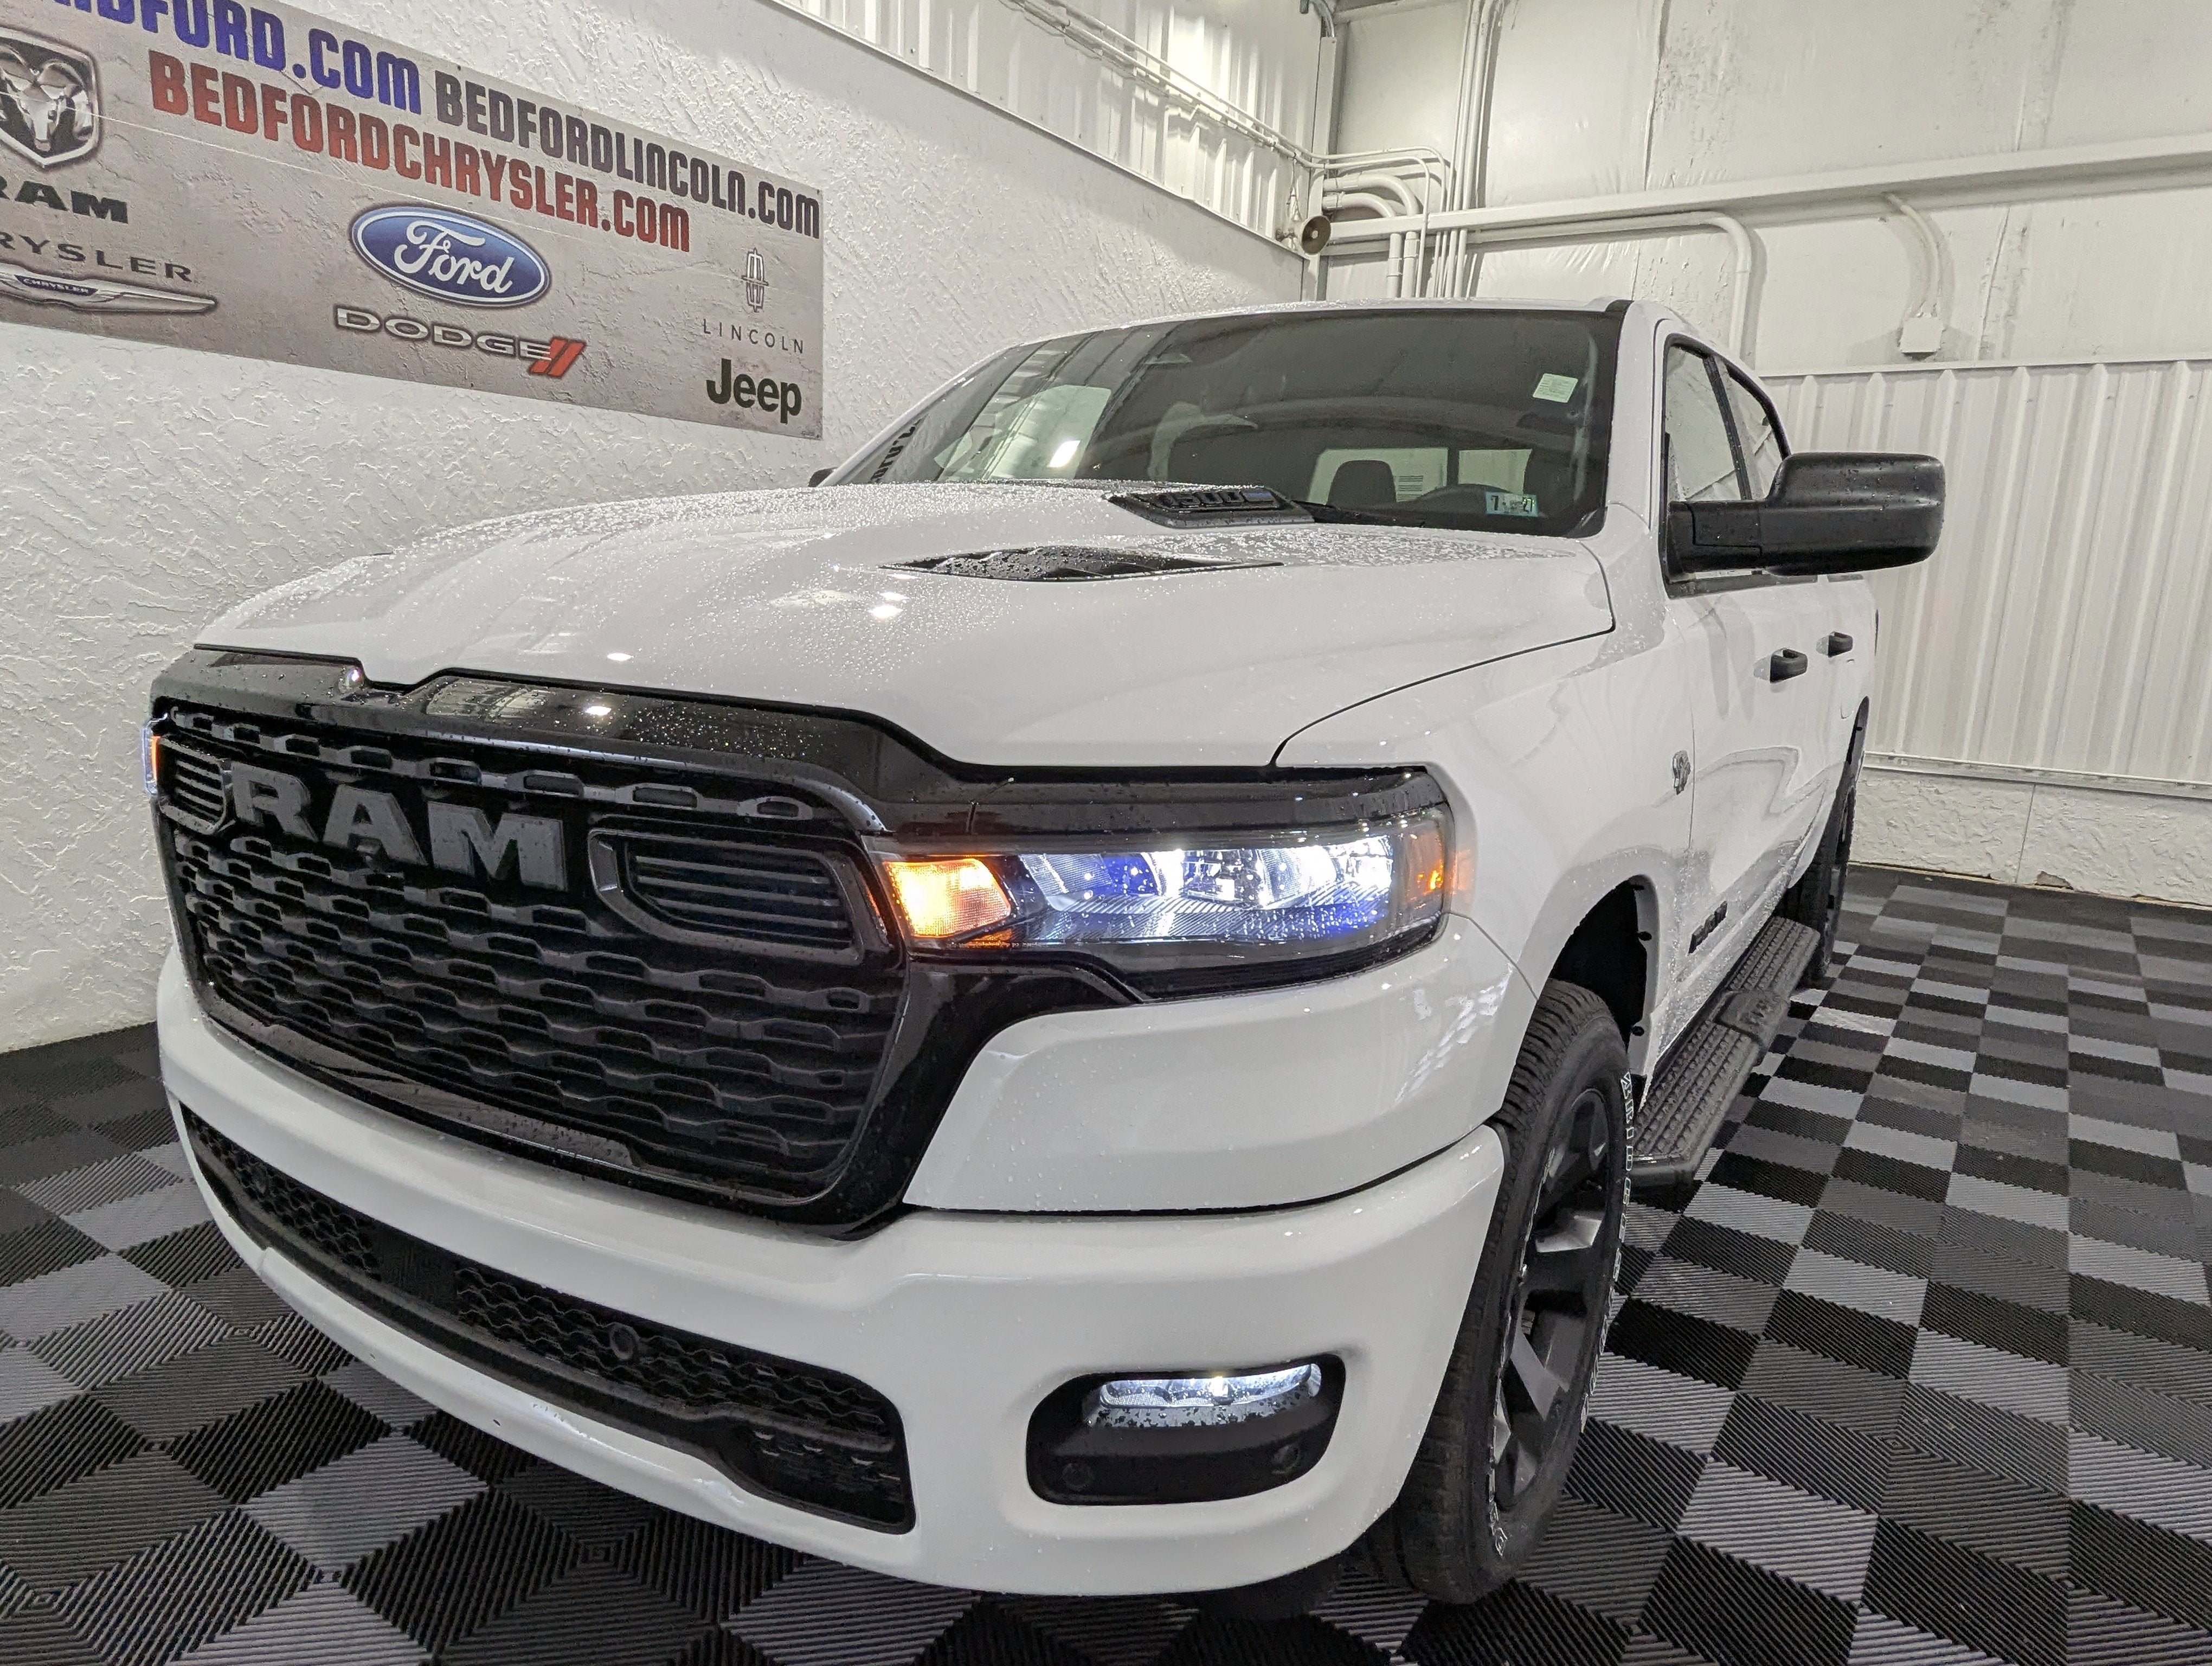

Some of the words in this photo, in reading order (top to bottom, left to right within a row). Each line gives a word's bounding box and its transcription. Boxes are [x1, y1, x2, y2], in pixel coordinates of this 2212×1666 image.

[149, 49, 690, 252] BEDFORDCHRYSLER.COM
[435, 70, 820, 239] BEDFORDLINCOLN.COM
[0, 176, 128, 224] AM
[394, 220, 513, 294] Ford
[333, 306, 553, 360] DODGE
[703, 318, 803, 354] LINCOLN
[706, 357, 802, 425] Jeep
[230, 760, 568, 893] RAM
